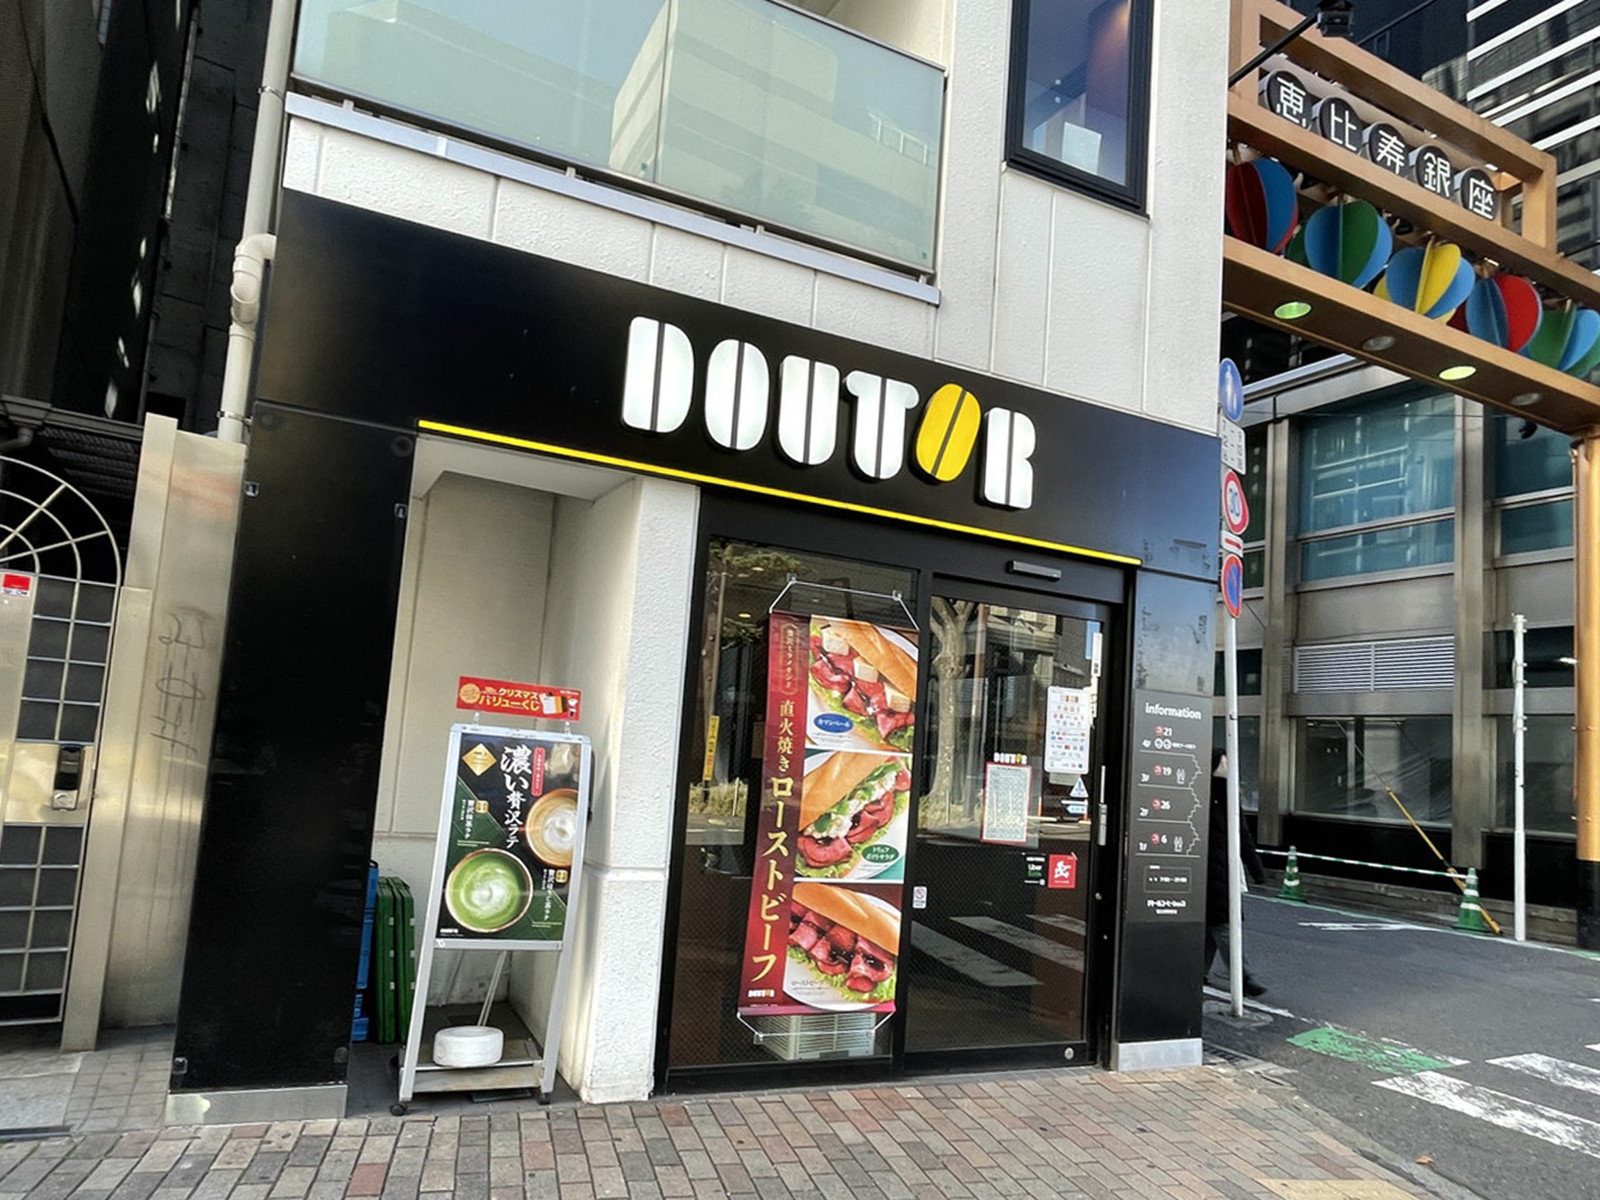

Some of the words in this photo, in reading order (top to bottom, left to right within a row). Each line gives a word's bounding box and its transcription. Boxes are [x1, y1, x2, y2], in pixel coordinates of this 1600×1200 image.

[1276, 76, 1495, 220] 恵比寿銀座
[622, 316, 1037, 510] DOUTOR
[479, 694, 540, 711] バリューくじ
[498, 687, 538, 700] クリスマス
[500, 744, 533, 849] 濃い贅沢ラテ
[751, 700, 796, 983] 直火焼きローストビーフ
[1161, 834, 1168, 844] 6
